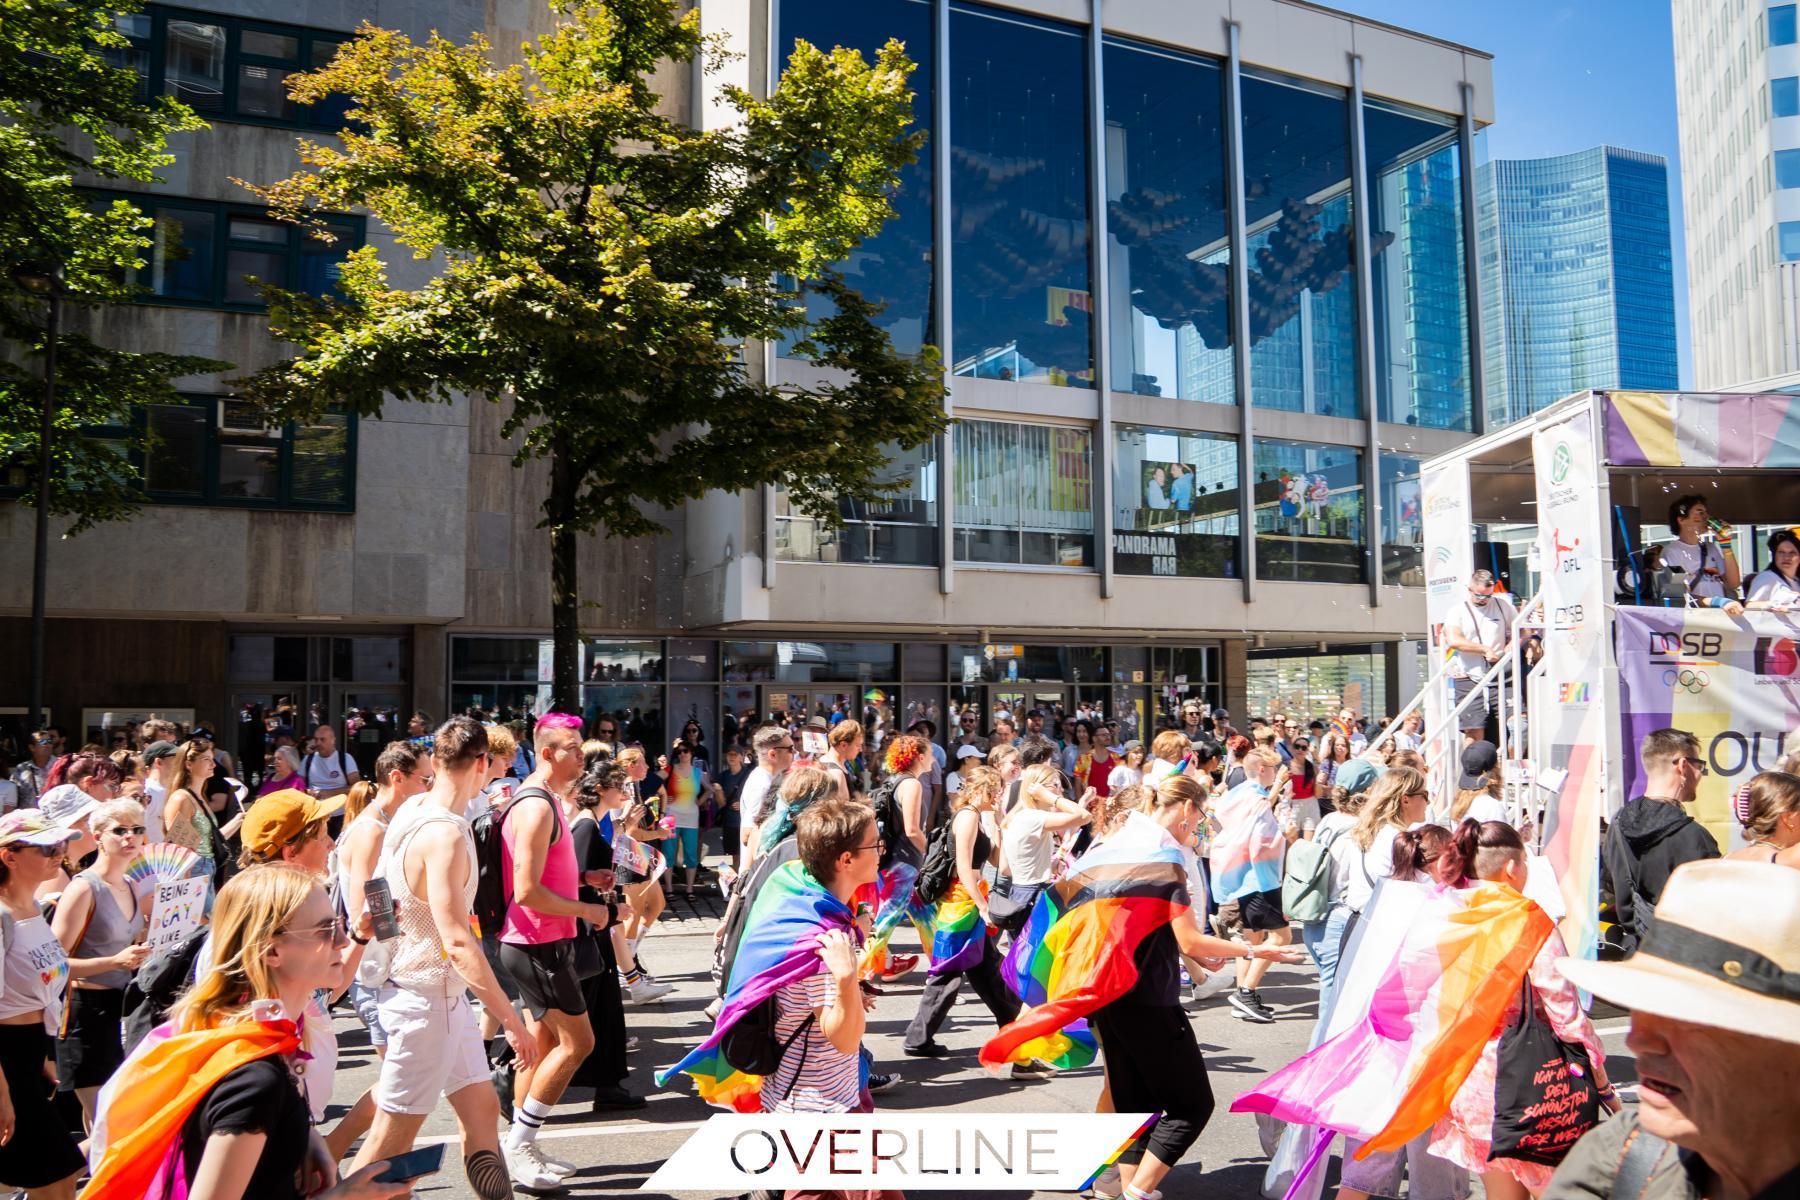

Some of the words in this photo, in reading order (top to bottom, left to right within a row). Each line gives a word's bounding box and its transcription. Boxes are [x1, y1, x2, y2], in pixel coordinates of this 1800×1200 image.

[1112, 535, 1176, 555] PANORAMA
[1564, 558, 1581, 573] DFL
[1649, 632, 1722, 656] DOSB
[160, 882, 190, 903] BEING
[162, 902, 192, 928] GAY
[160, 930, 181, 945] LIKE
[1543, 1082, 1570, 1100] DEN
[1536, 1110, 1580, 1131] ARSCH
